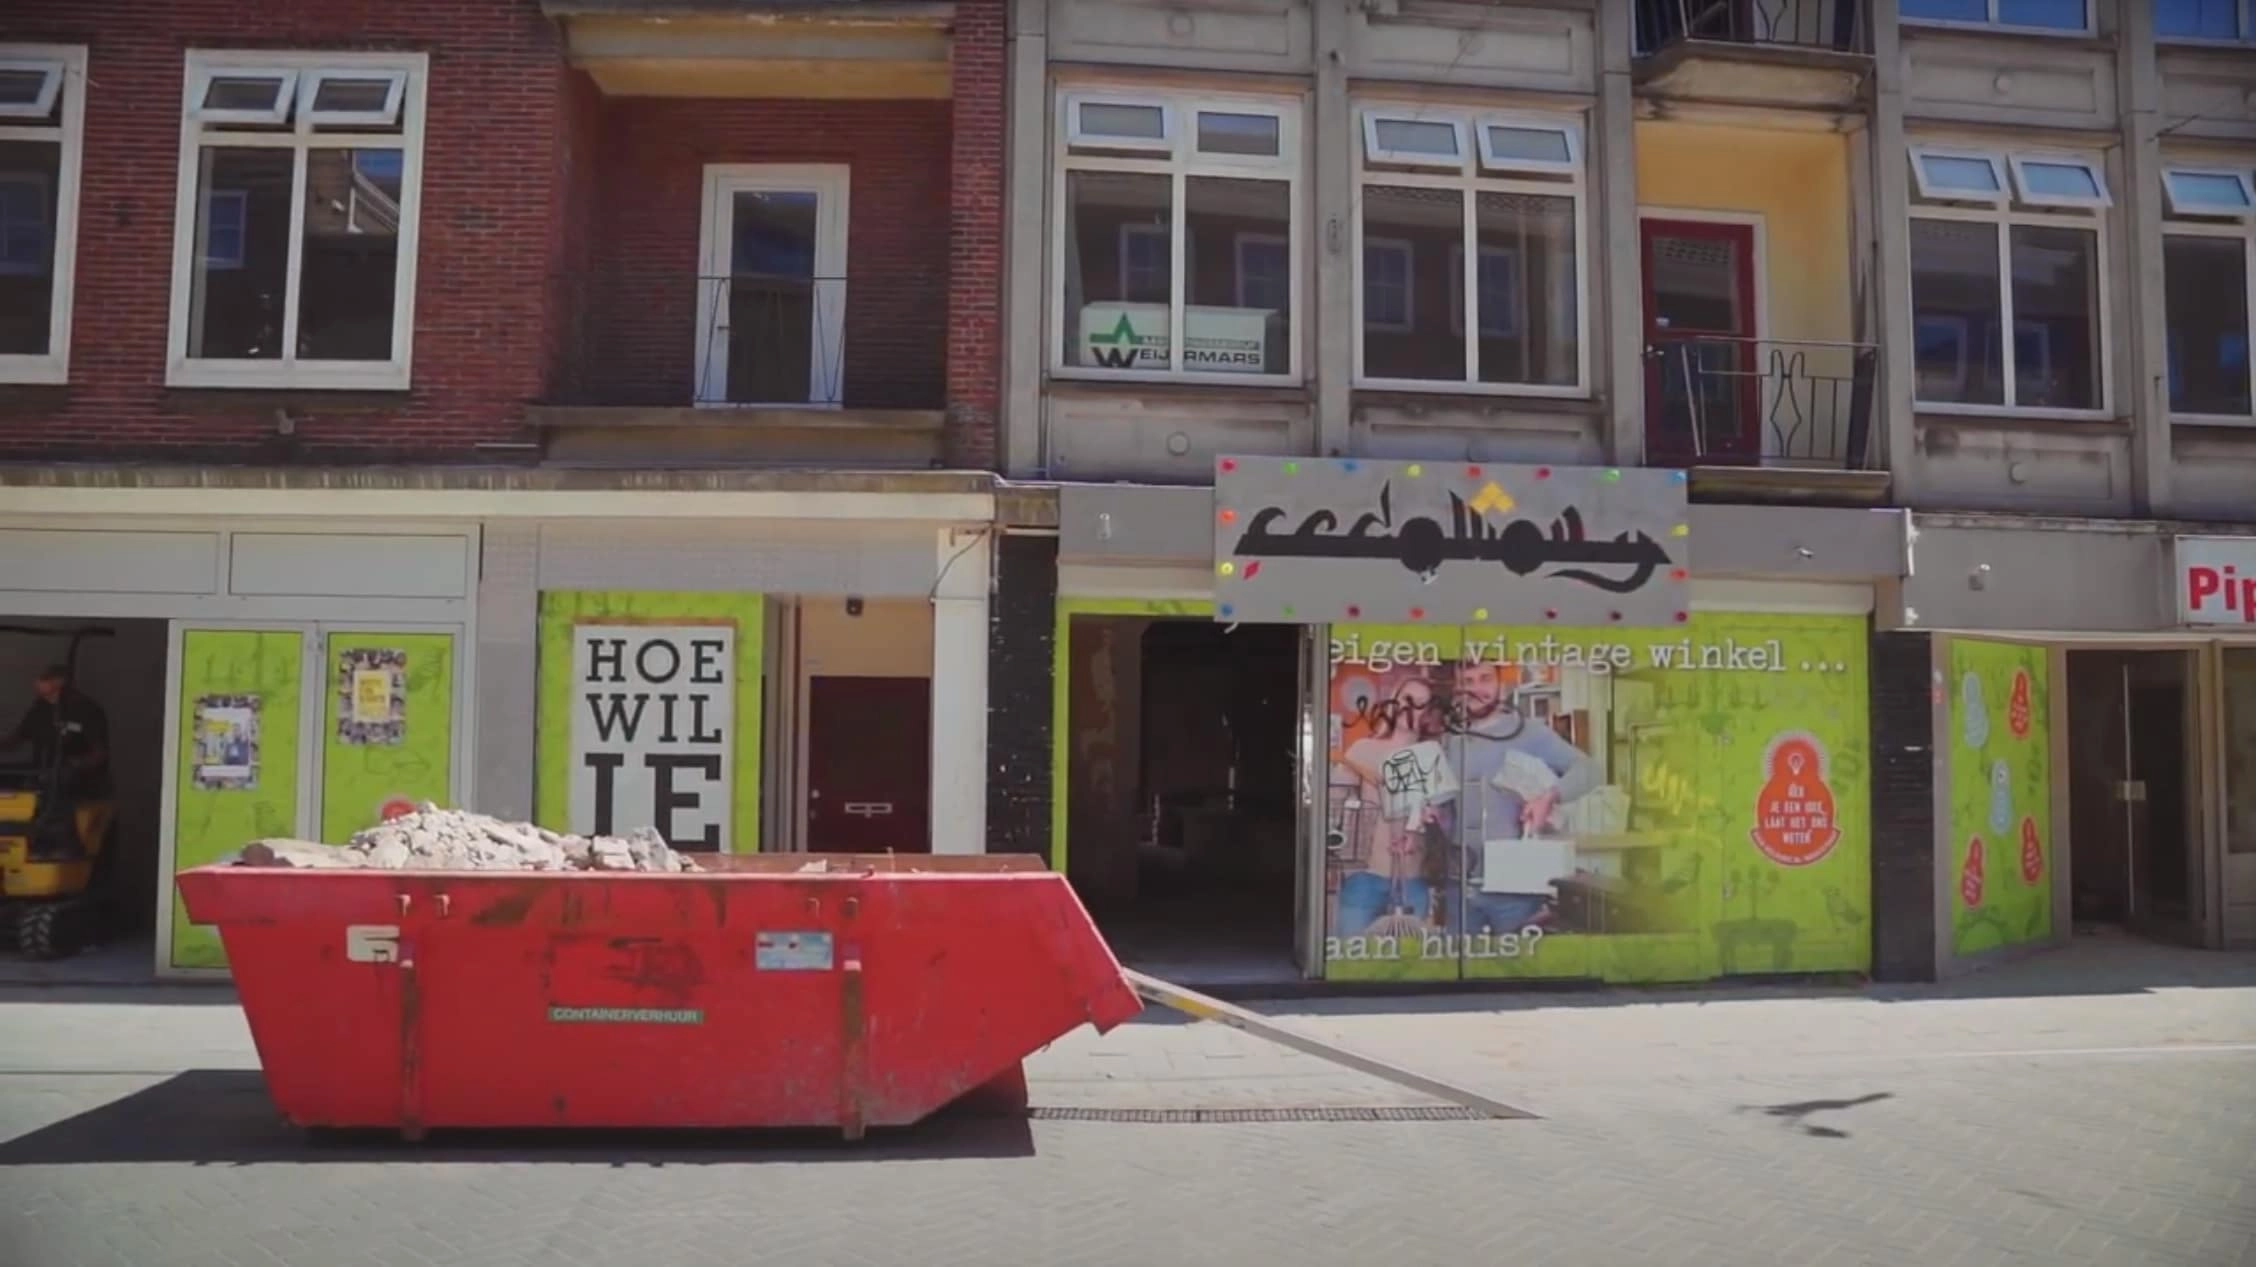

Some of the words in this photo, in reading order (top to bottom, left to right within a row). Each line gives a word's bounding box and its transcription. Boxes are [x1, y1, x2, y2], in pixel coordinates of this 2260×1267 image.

[1091, 348, 1260, 368] WEIJRMARS
[586, 638, 723, 683] HOE
[1331, 635, 1442, 673] eigen
[1465, 635, 1631, 673] vintage
[1651, 639, 1786, 670] winkel
[586, 693, 722, 743] WIL
[1326, 935, 1400, 960] aan
[1420, 925, 1544, 959] huis?
[553, 1006, 699, 1023] CONTAINERVERHUUR
